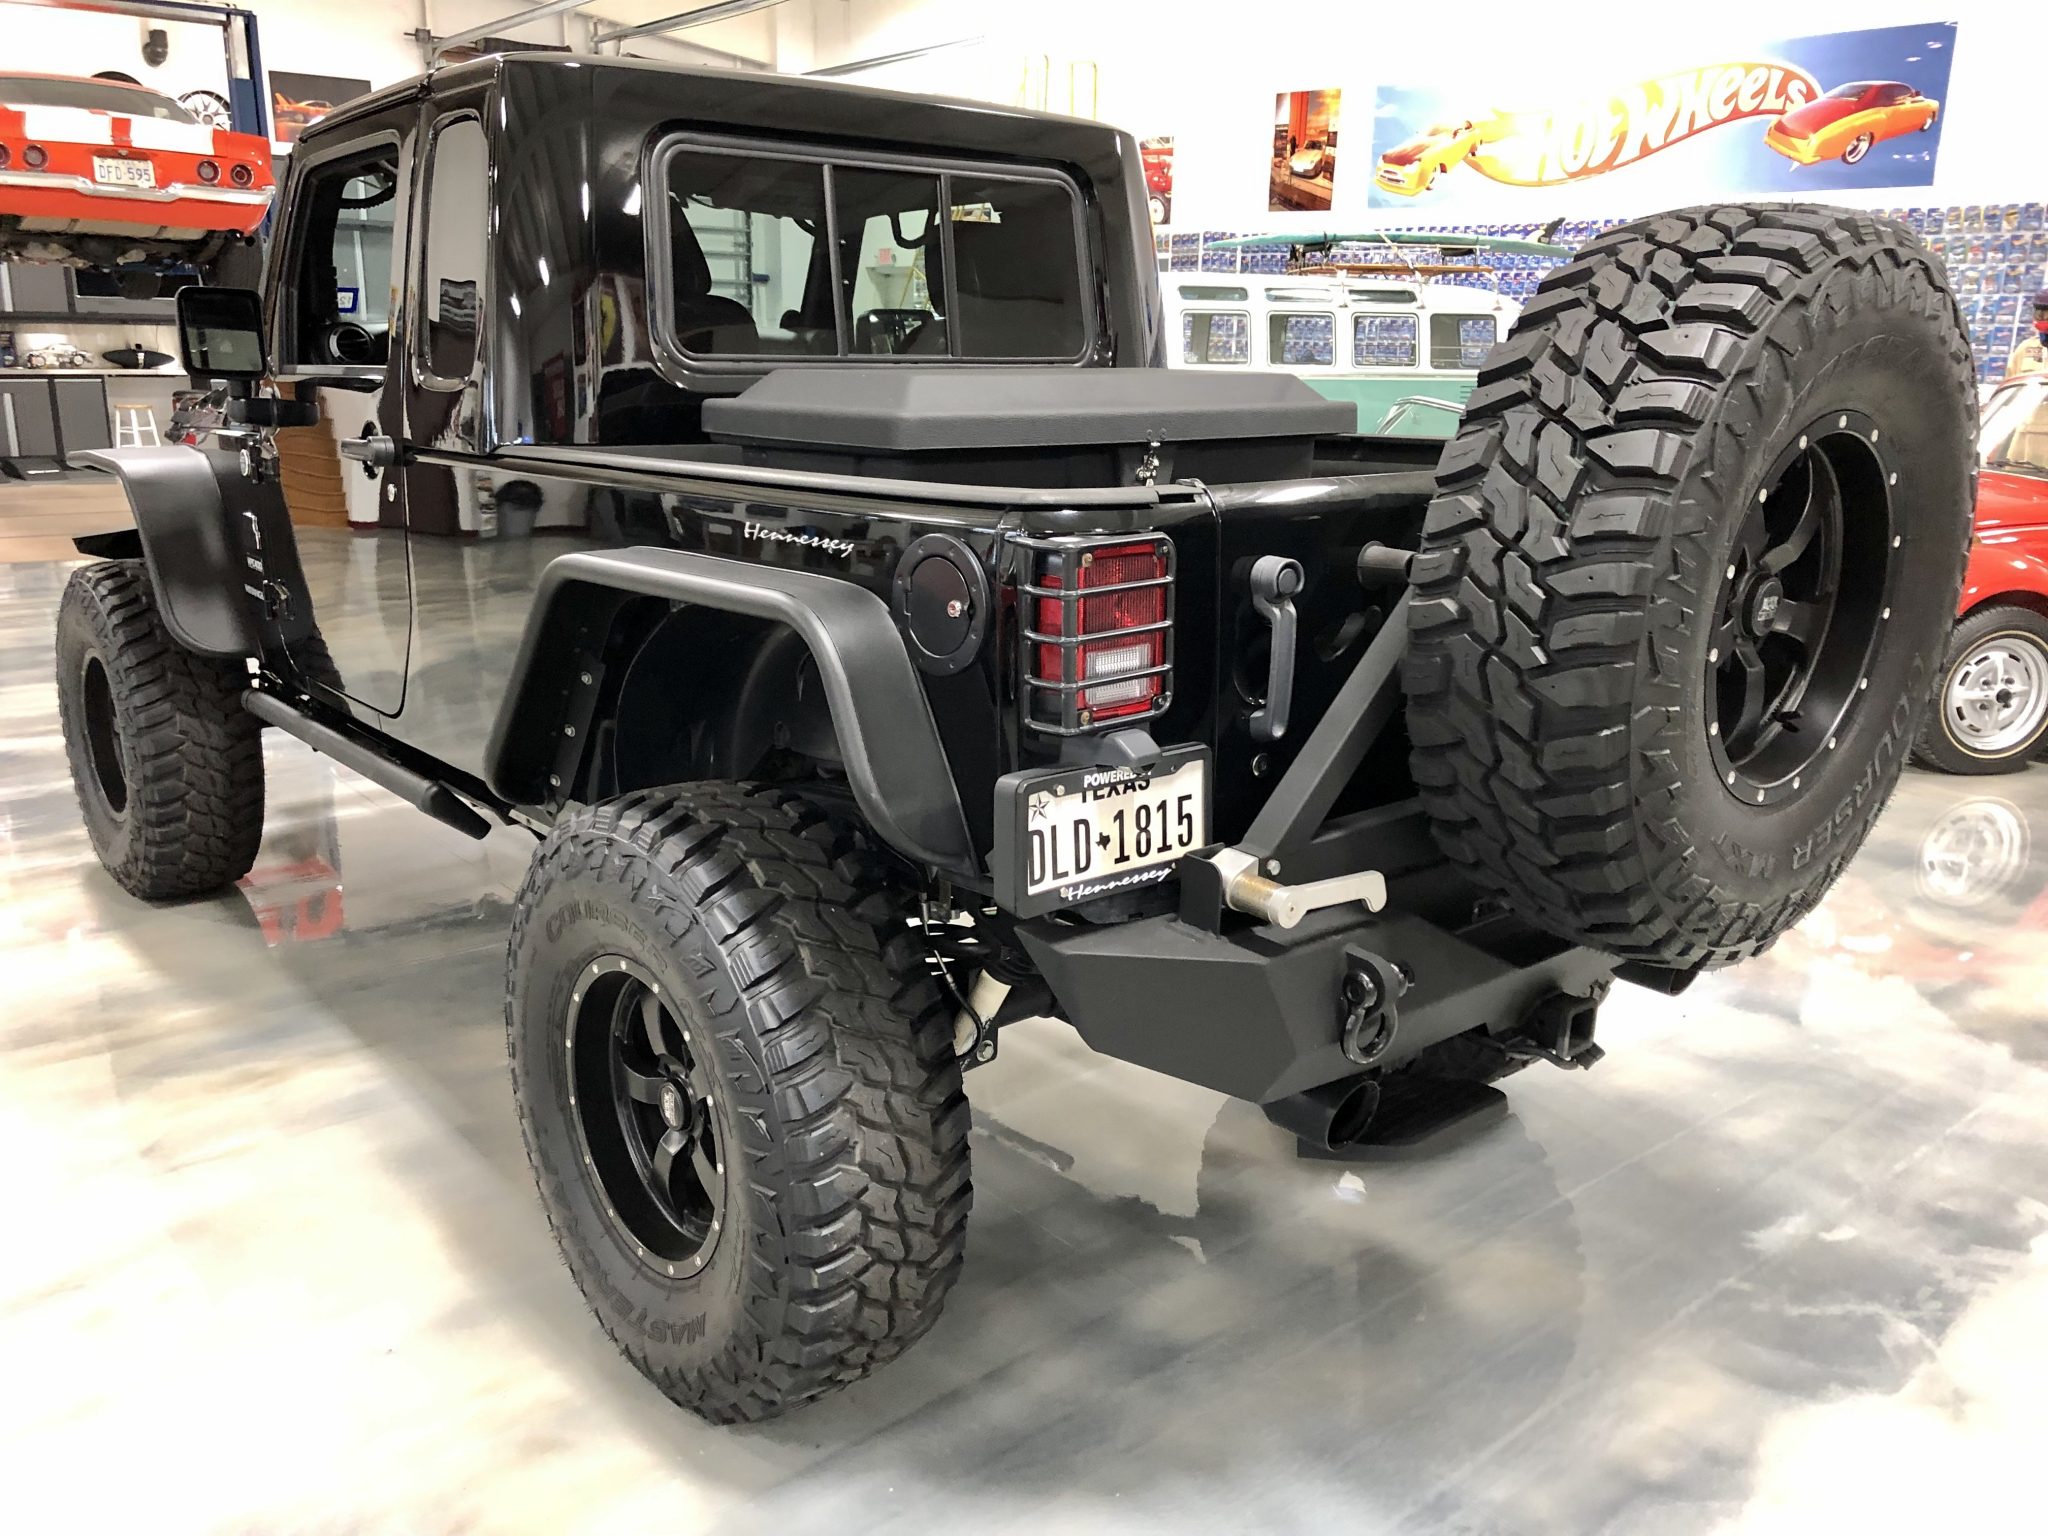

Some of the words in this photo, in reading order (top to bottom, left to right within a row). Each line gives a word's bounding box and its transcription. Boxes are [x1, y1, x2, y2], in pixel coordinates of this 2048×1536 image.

[127, 167, 151, 182] 595
[743, 521, 855, 558] Hennessey
[1113, 794, 1194, 865] 1815
[1067, 866, 1173, 901] Hennessey
